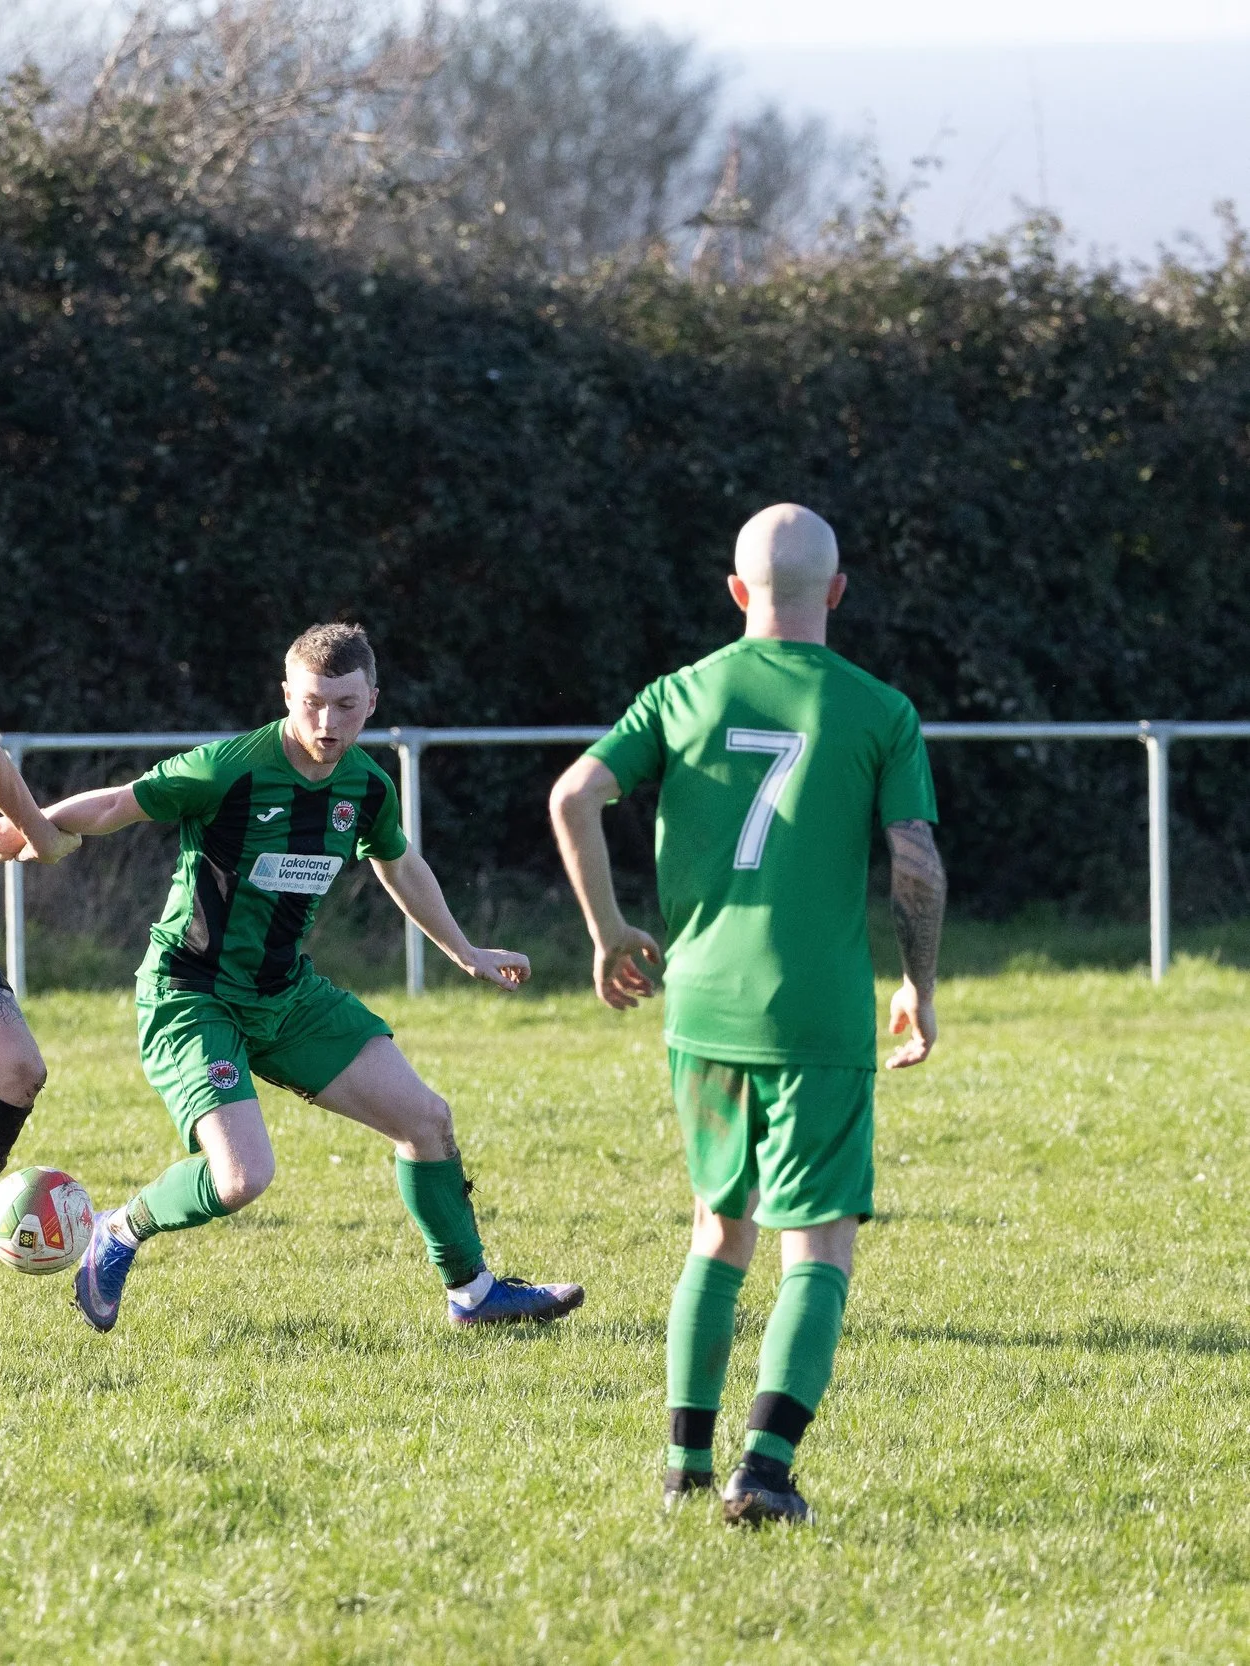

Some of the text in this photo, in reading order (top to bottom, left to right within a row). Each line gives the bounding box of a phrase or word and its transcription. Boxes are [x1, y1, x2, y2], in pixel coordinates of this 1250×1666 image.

[726, 727, 808, 869] 7
[280, 857, 331, 870] Lakeland
[278, 868, 335, 882] Verandahs
